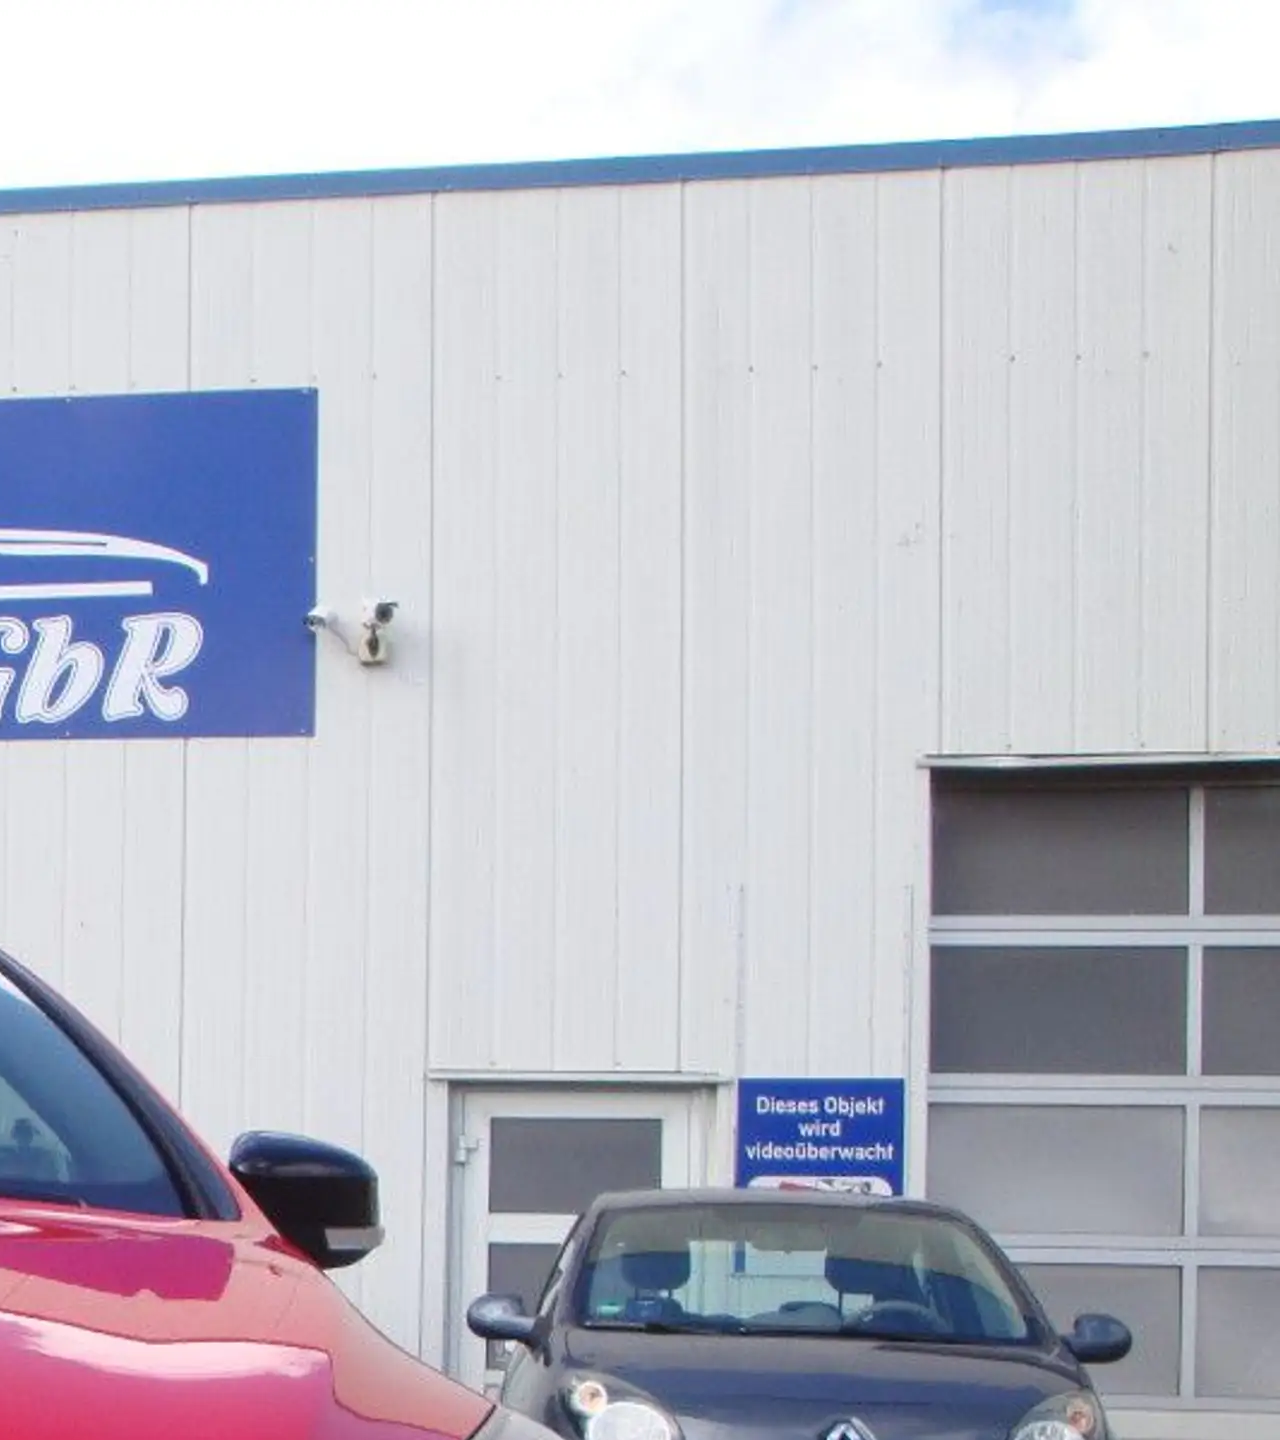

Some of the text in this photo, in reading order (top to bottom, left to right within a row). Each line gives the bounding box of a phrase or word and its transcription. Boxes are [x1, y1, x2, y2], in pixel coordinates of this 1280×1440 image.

[756, 1096, 884, 1117] Dieses Objekt
[798, 1119, 841, 1137] wird
[745, 1142, 895, 1161] videoüberwacht
